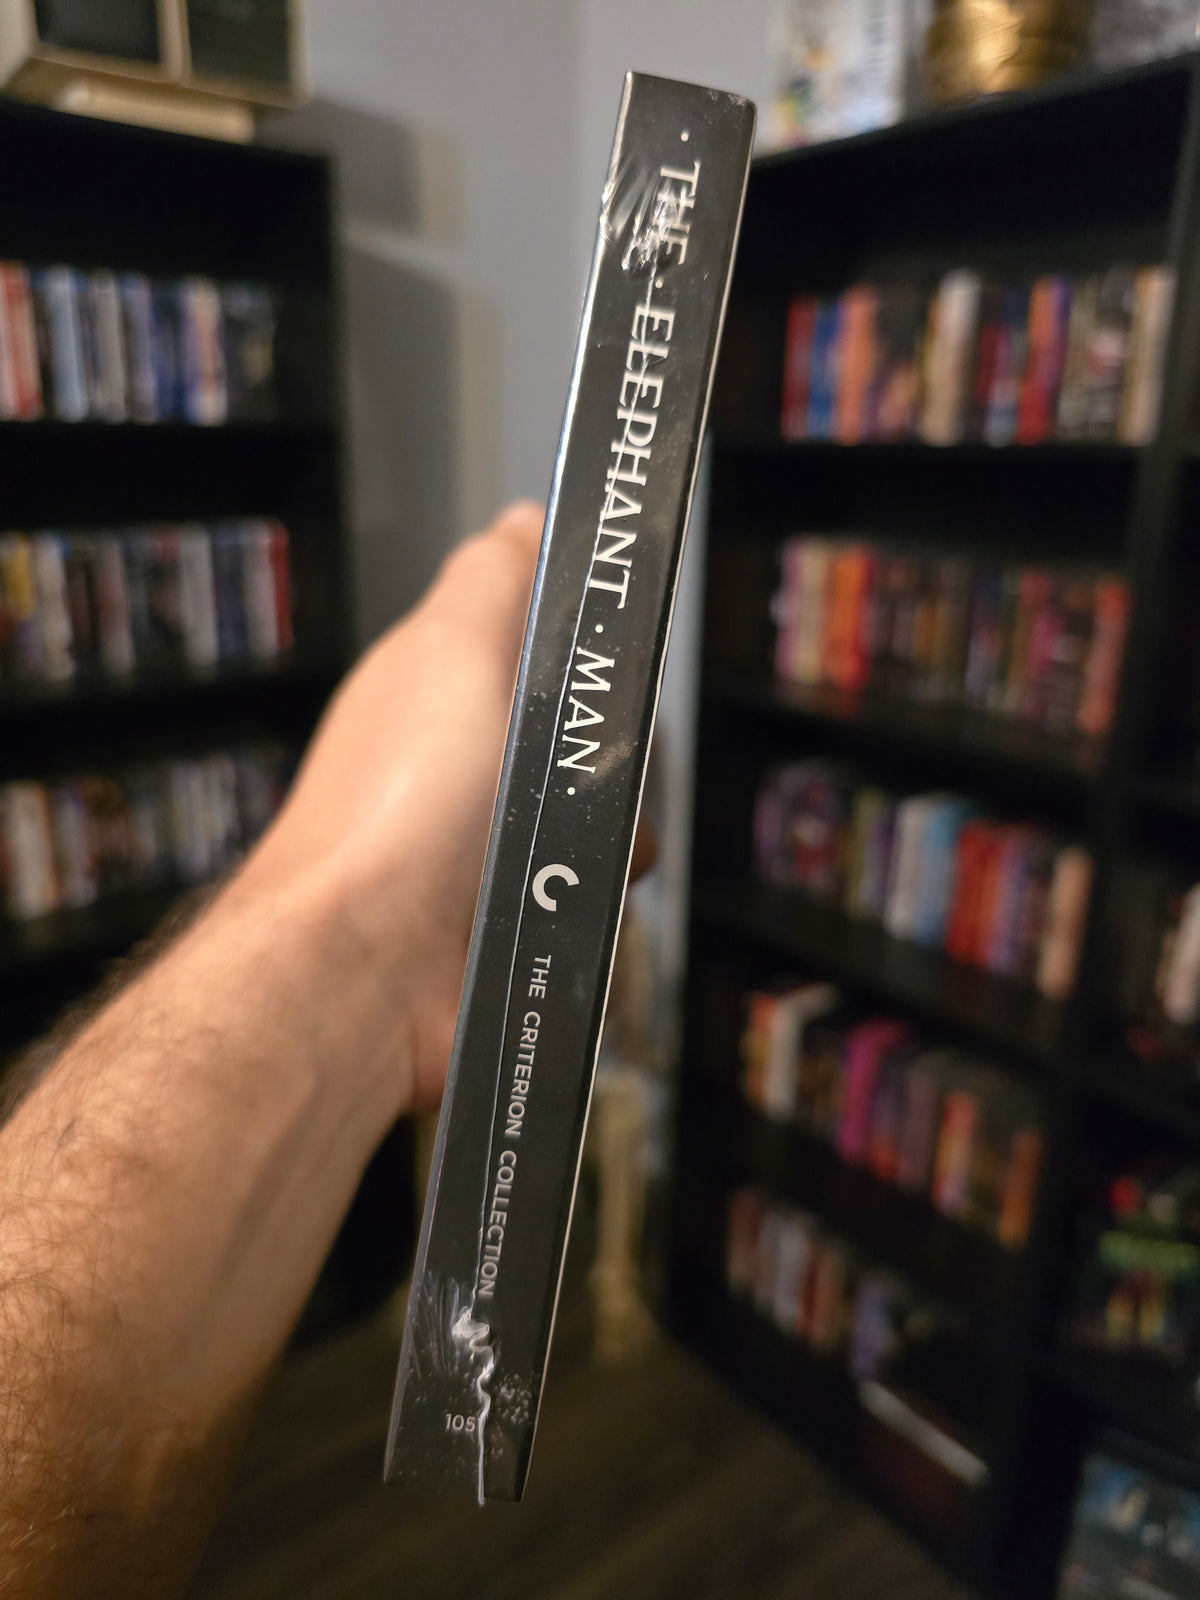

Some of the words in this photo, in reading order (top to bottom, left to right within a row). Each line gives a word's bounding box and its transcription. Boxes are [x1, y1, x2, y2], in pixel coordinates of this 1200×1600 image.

[649, 160, 701, 265] THE
[588, 303, 675, 609] ELEPHANT
[557, 646, 615, 774] MAN
[528, 954, 552, 999] THE
[504, 1011, 541, 1137] CRITERION
[478, 1150, 517, 1298] COLLECTION
